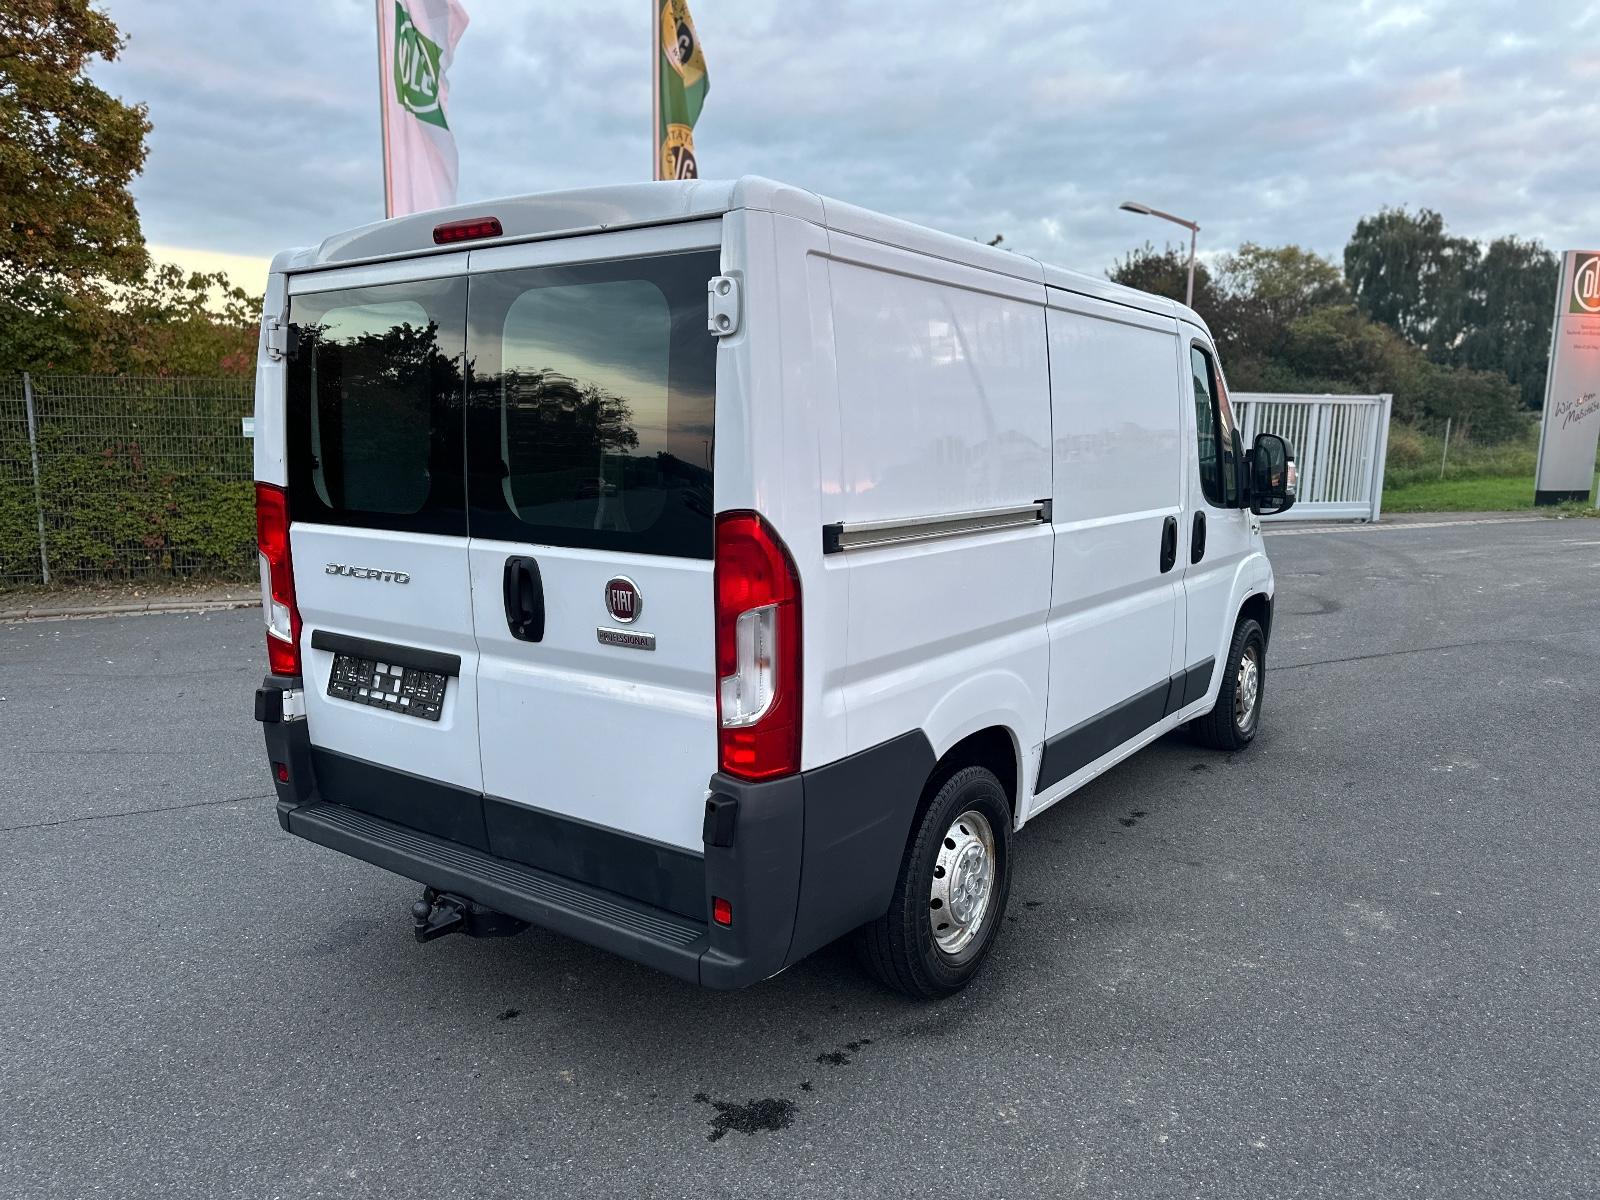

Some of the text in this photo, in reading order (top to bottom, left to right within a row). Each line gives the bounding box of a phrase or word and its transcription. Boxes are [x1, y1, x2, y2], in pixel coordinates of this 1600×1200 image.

[1583, 260, 1600, 298] DL
[325, 562, 411, 584] DUCATO
[611, 589, 633, 612] FIAT
[599, 632, 649, 646] PROFESSIONAL
